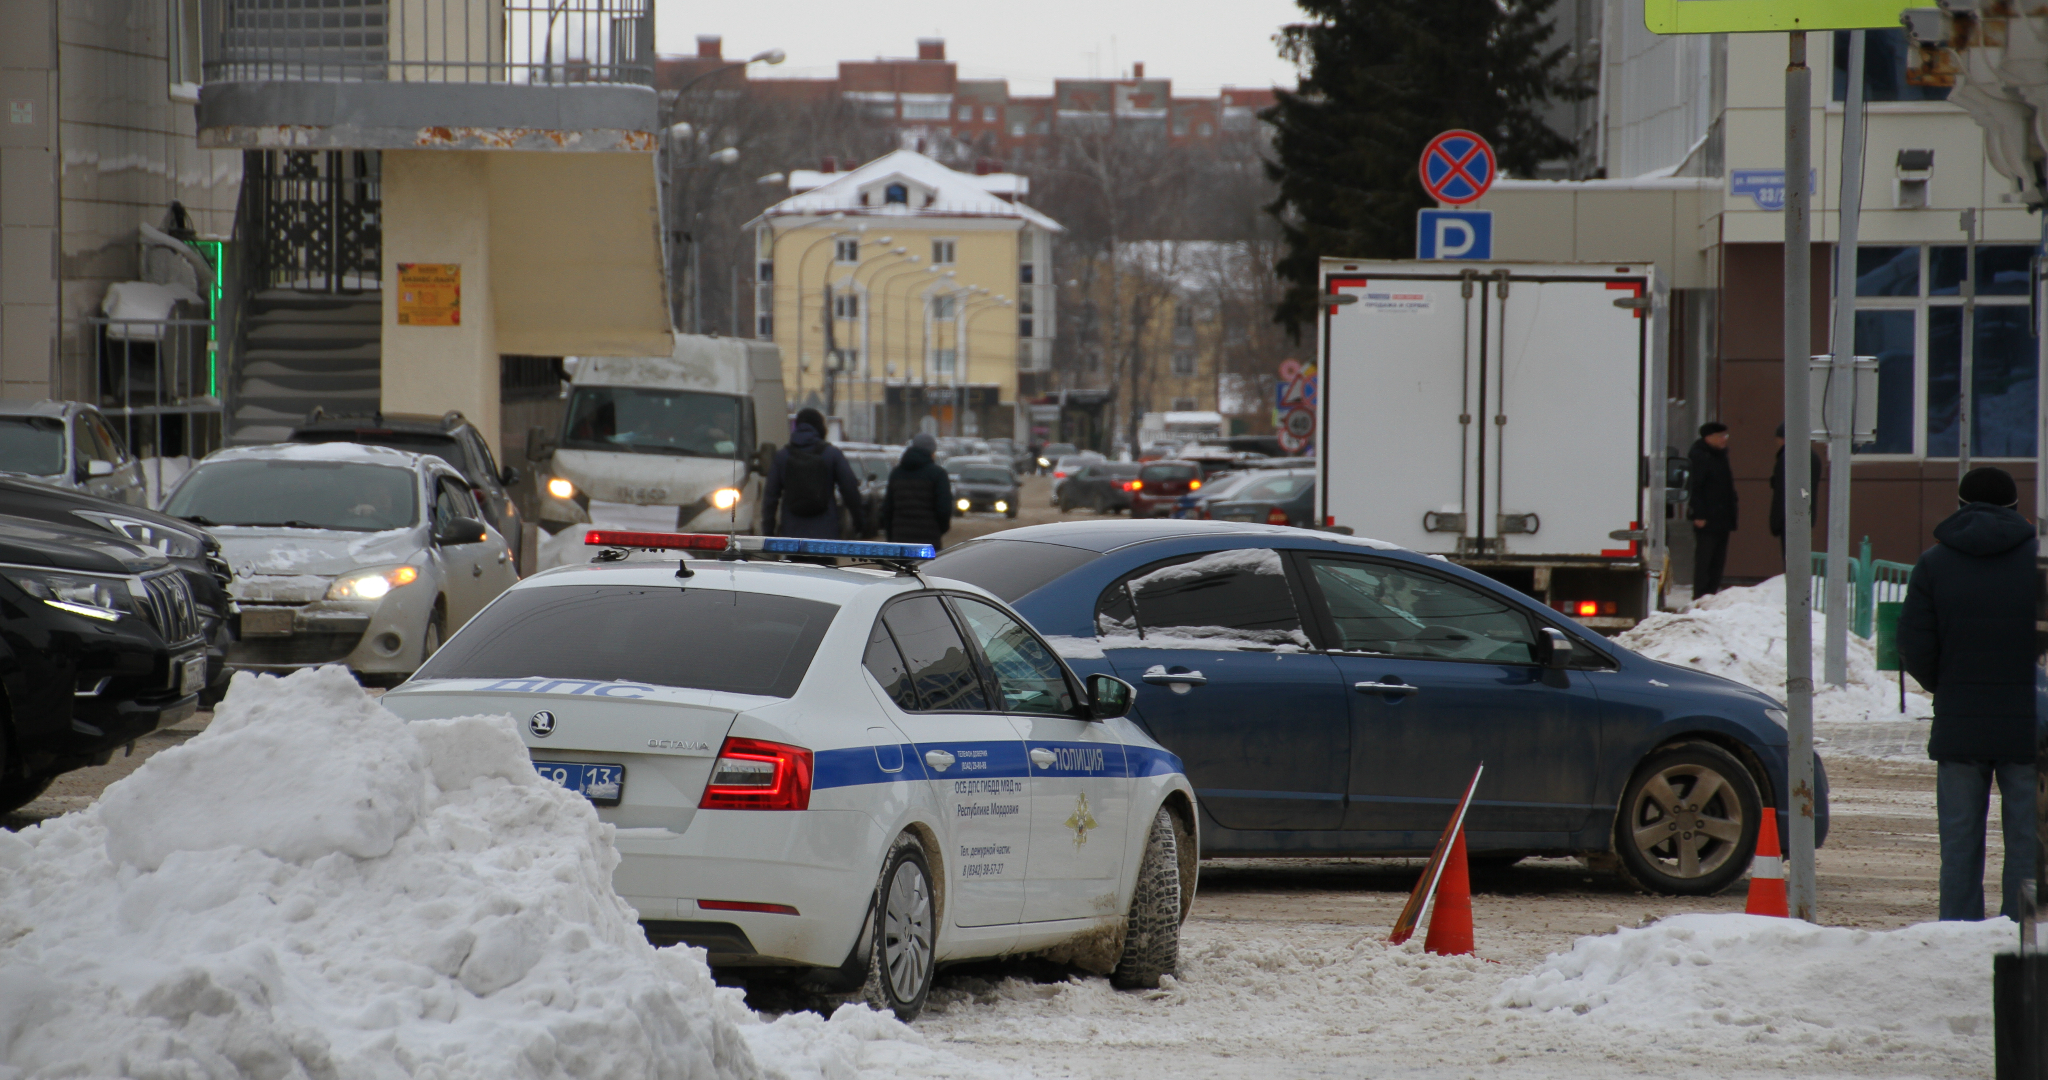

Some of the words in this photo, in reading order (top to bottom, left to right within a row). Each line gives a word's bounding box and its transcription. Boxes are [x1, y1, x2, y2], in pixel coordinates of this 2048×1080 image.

[1434, 217, 1476, 260] P
[473, 679, 655, 699] ДПС
[647, 738, 710, 751] OCTAVIA
[1054, 747, 1105, 775] ПОЛИЦИЯ
[586, 767, 611, 787] 13
[955, 781, 967, 794] ОСБ
[968, 780, 980, 796] ДПС
[981, 779, 1000, 795] ГИБДД
[1001, 779, 1015, 794] МВД
[957, 803, 990, 819] Республике
[990, 802, 1019, 818] Мордовия
